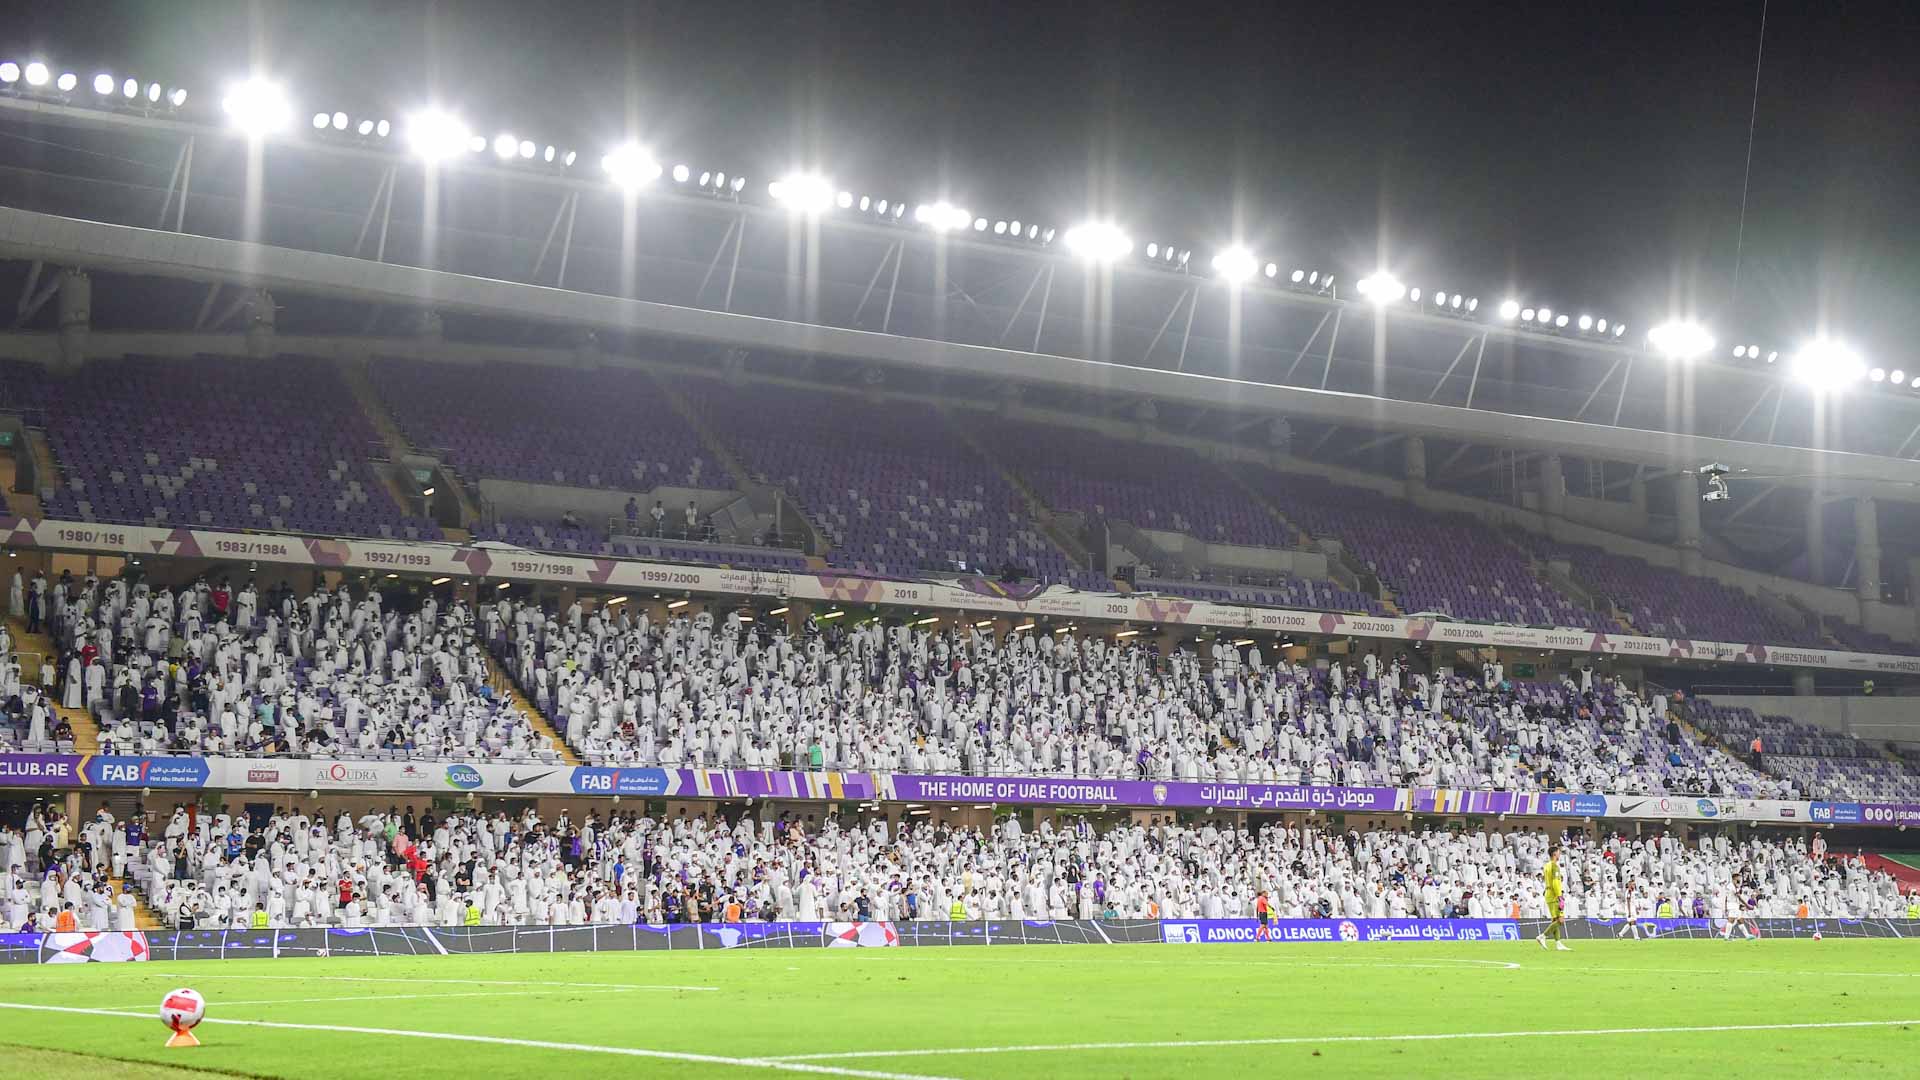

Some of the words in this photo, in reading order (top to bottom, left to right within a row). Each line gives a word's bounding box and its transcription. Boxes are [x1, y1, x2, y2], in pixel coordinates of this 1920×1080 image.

[215, 540, 288, 556] 1983/1984
[364, 552, 431, 565] 1992/1993
[511, 561, 574, 575] 1997/1998
[641, 571, 700, 584] 1999/2000
[894, 588, 918, 599] 2018
[1106, 603, 1129, 614] 2003
[1261, 615, 1306, 626] 2001/2002
[1352, 621, 1395, 632] 2002/2003
[1443, 628, 1484, 639] 2003/2004
[1545, 635, 1584, 646] 2011/2012
[1623, 641, 1661, 652] 2012/2013
[1771, 651, 1828, 665] @HBZSTADIUM
[102, 764, 139, 781] FAB
[452, 773, 480, 782] OASIS
[581, 774, 612, 790] FAB
[919, 781, 947, 797] THE
[951, 782, 994, 798] HOME
[997, 783, 1015, 798] OF
[1020, 784, 1047, 799] UAE
[1050, 785, 1118, 801] FOOTBALL
[1200, 786, 1248, 806] الإمارات
[1250, 787, 1273, 807] في
[1275, 788, 1309, 807] القدم
[1312, 788, 1334, 807] كرة
[1337, 790, 1375, 807] موطن
[1551, 800, 1571, 812] FAB
[1813, 807, 1831, 819] FAB
[1207, 927, 1254, 940] ADNOC
[1285, 927, 1333, 940] LEAGUE
